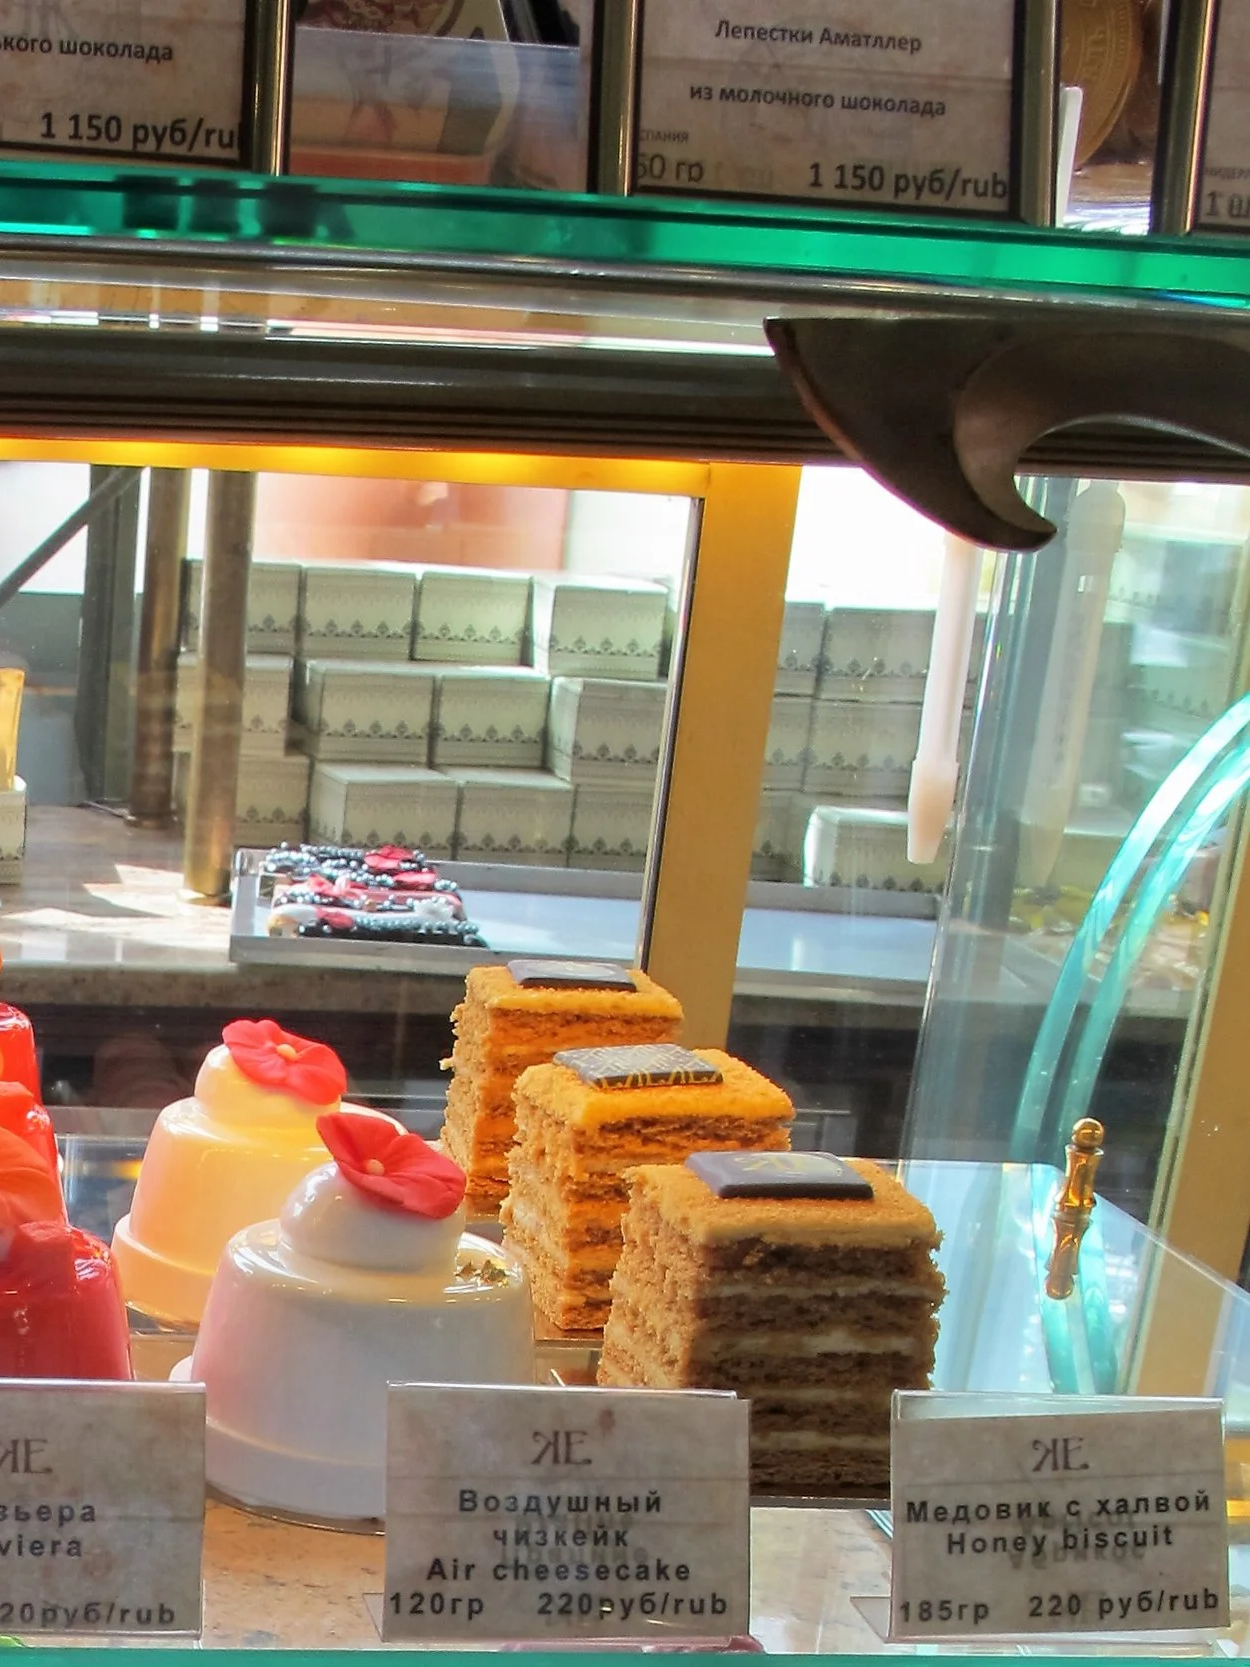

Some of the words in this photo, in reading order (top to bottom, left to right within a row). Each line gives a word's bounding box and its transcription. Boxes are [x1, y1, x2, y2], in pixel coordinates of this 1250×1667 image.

[59, 39, 175, 64] шоколада
[714, 19, 814, 46] Лепестки
[819, 27, 923, 55] Аматллер
[689, 83, 714, 104] из
[718, 86, 836, 110] молочного
[839, 93, 948, 119] шоколада
[67, 114, 123, 145] 150
[131, 117, 244, 153] руб/ru
[833, 163, 886, 193] 150
[893, 167, 1010, 203] руб/rub
[458, 1488, 662, 1519] Воздушный
[905, 1498, 1052, 1525] Медовик
[1065, 1499, 1081, 1518] с
[1096, 1489, 1211, 1518] халвой
[493, 1523, 630, 1548] чизкейк
[946, 1529, 1047, 1557] Honey
[1062, 1524, 1174, 1551] biscuit
[425, 1557, 476, 1582] Air
[492, 1557, 691, 1582] cheesecake
[388, 1591, 485, 1621] 120гр
[536, 1591, 728, 1621] 220руб/rub
[899, 1600, 991, 1626] 185гр
[1028, 1593, 1082, 1618] 220
[1099, 1588, 1220, 1621] руб/rub
